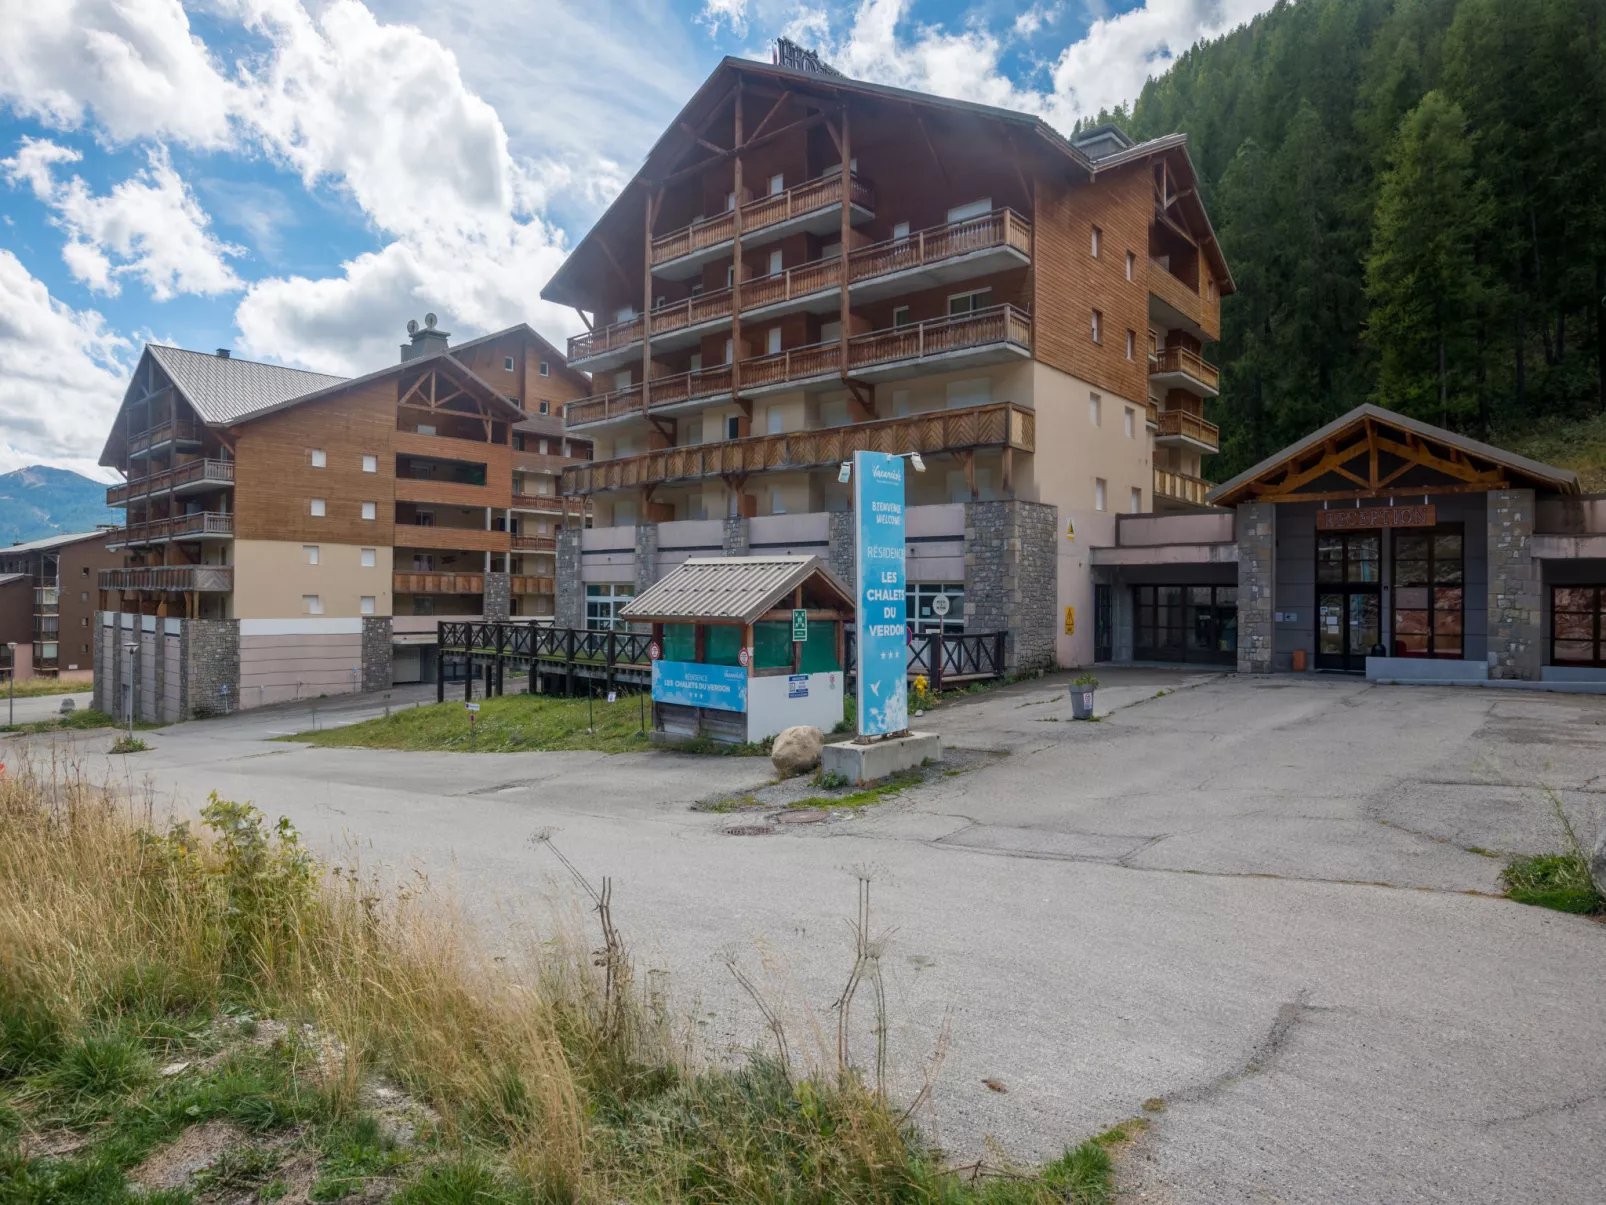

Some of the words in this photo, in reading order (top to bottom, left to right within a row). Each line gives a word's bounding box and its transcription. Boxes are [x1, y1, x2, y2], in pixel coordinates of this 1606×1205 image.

[1325, 509, 1428, 528] RECEPTION
[881, 571, 897, 583] LES
[866, 589, 905, 601] CHALETS
[883, 607, 896, 619] DU
[868, 624, 905, 637] VERDON
